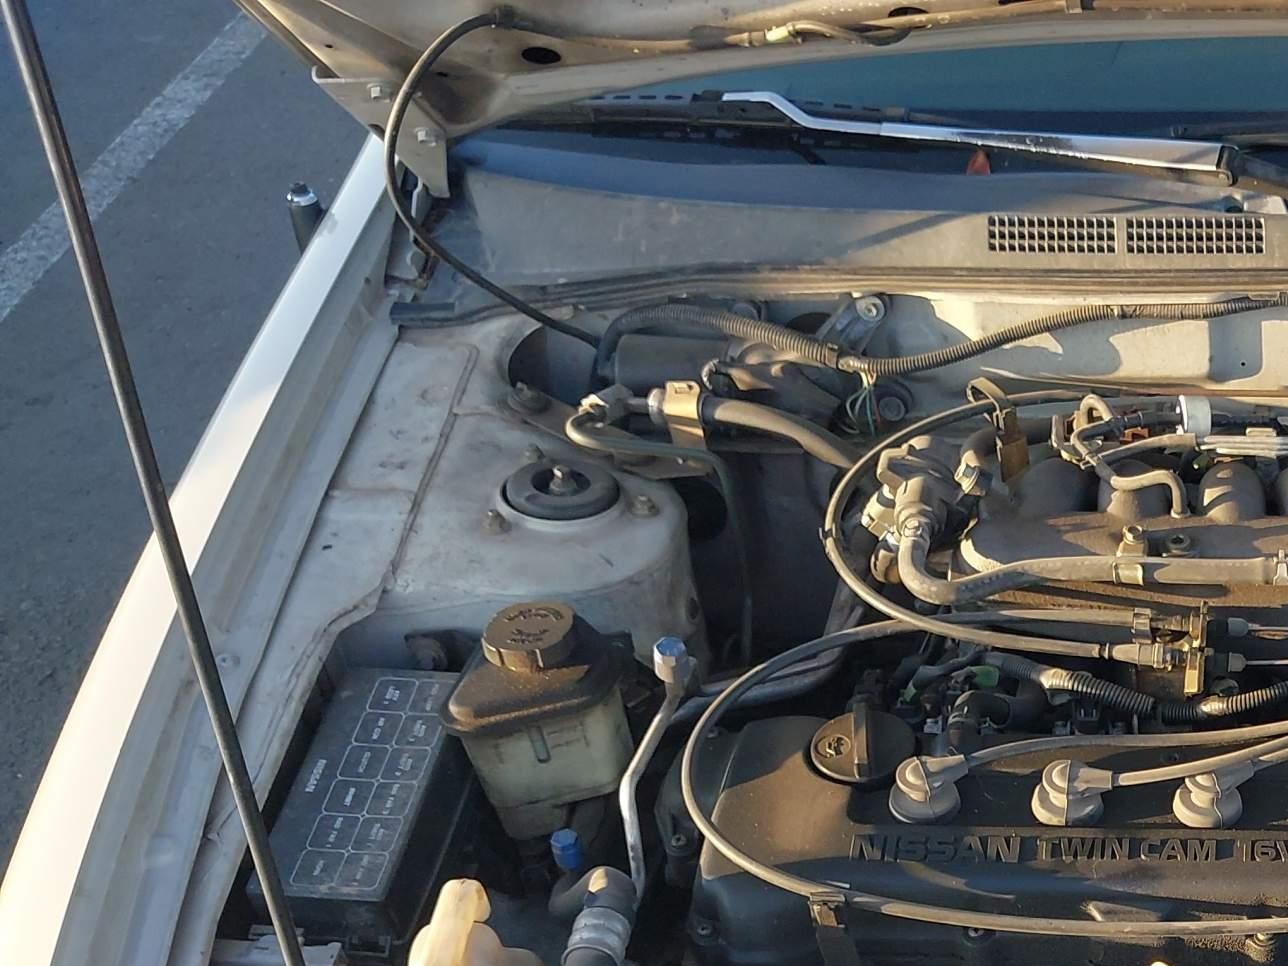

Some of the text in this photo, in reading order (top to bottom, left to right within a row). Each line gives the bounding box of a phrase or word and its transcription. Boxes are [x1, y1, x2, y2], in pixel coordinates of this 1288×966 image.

[304, 759, 328, 793] NISSAN
[850, 834, 1020, 863] NISSAN
[1036, 837, 1131, 863] TWIN
[1140, 838, 1217, 864] CAM
